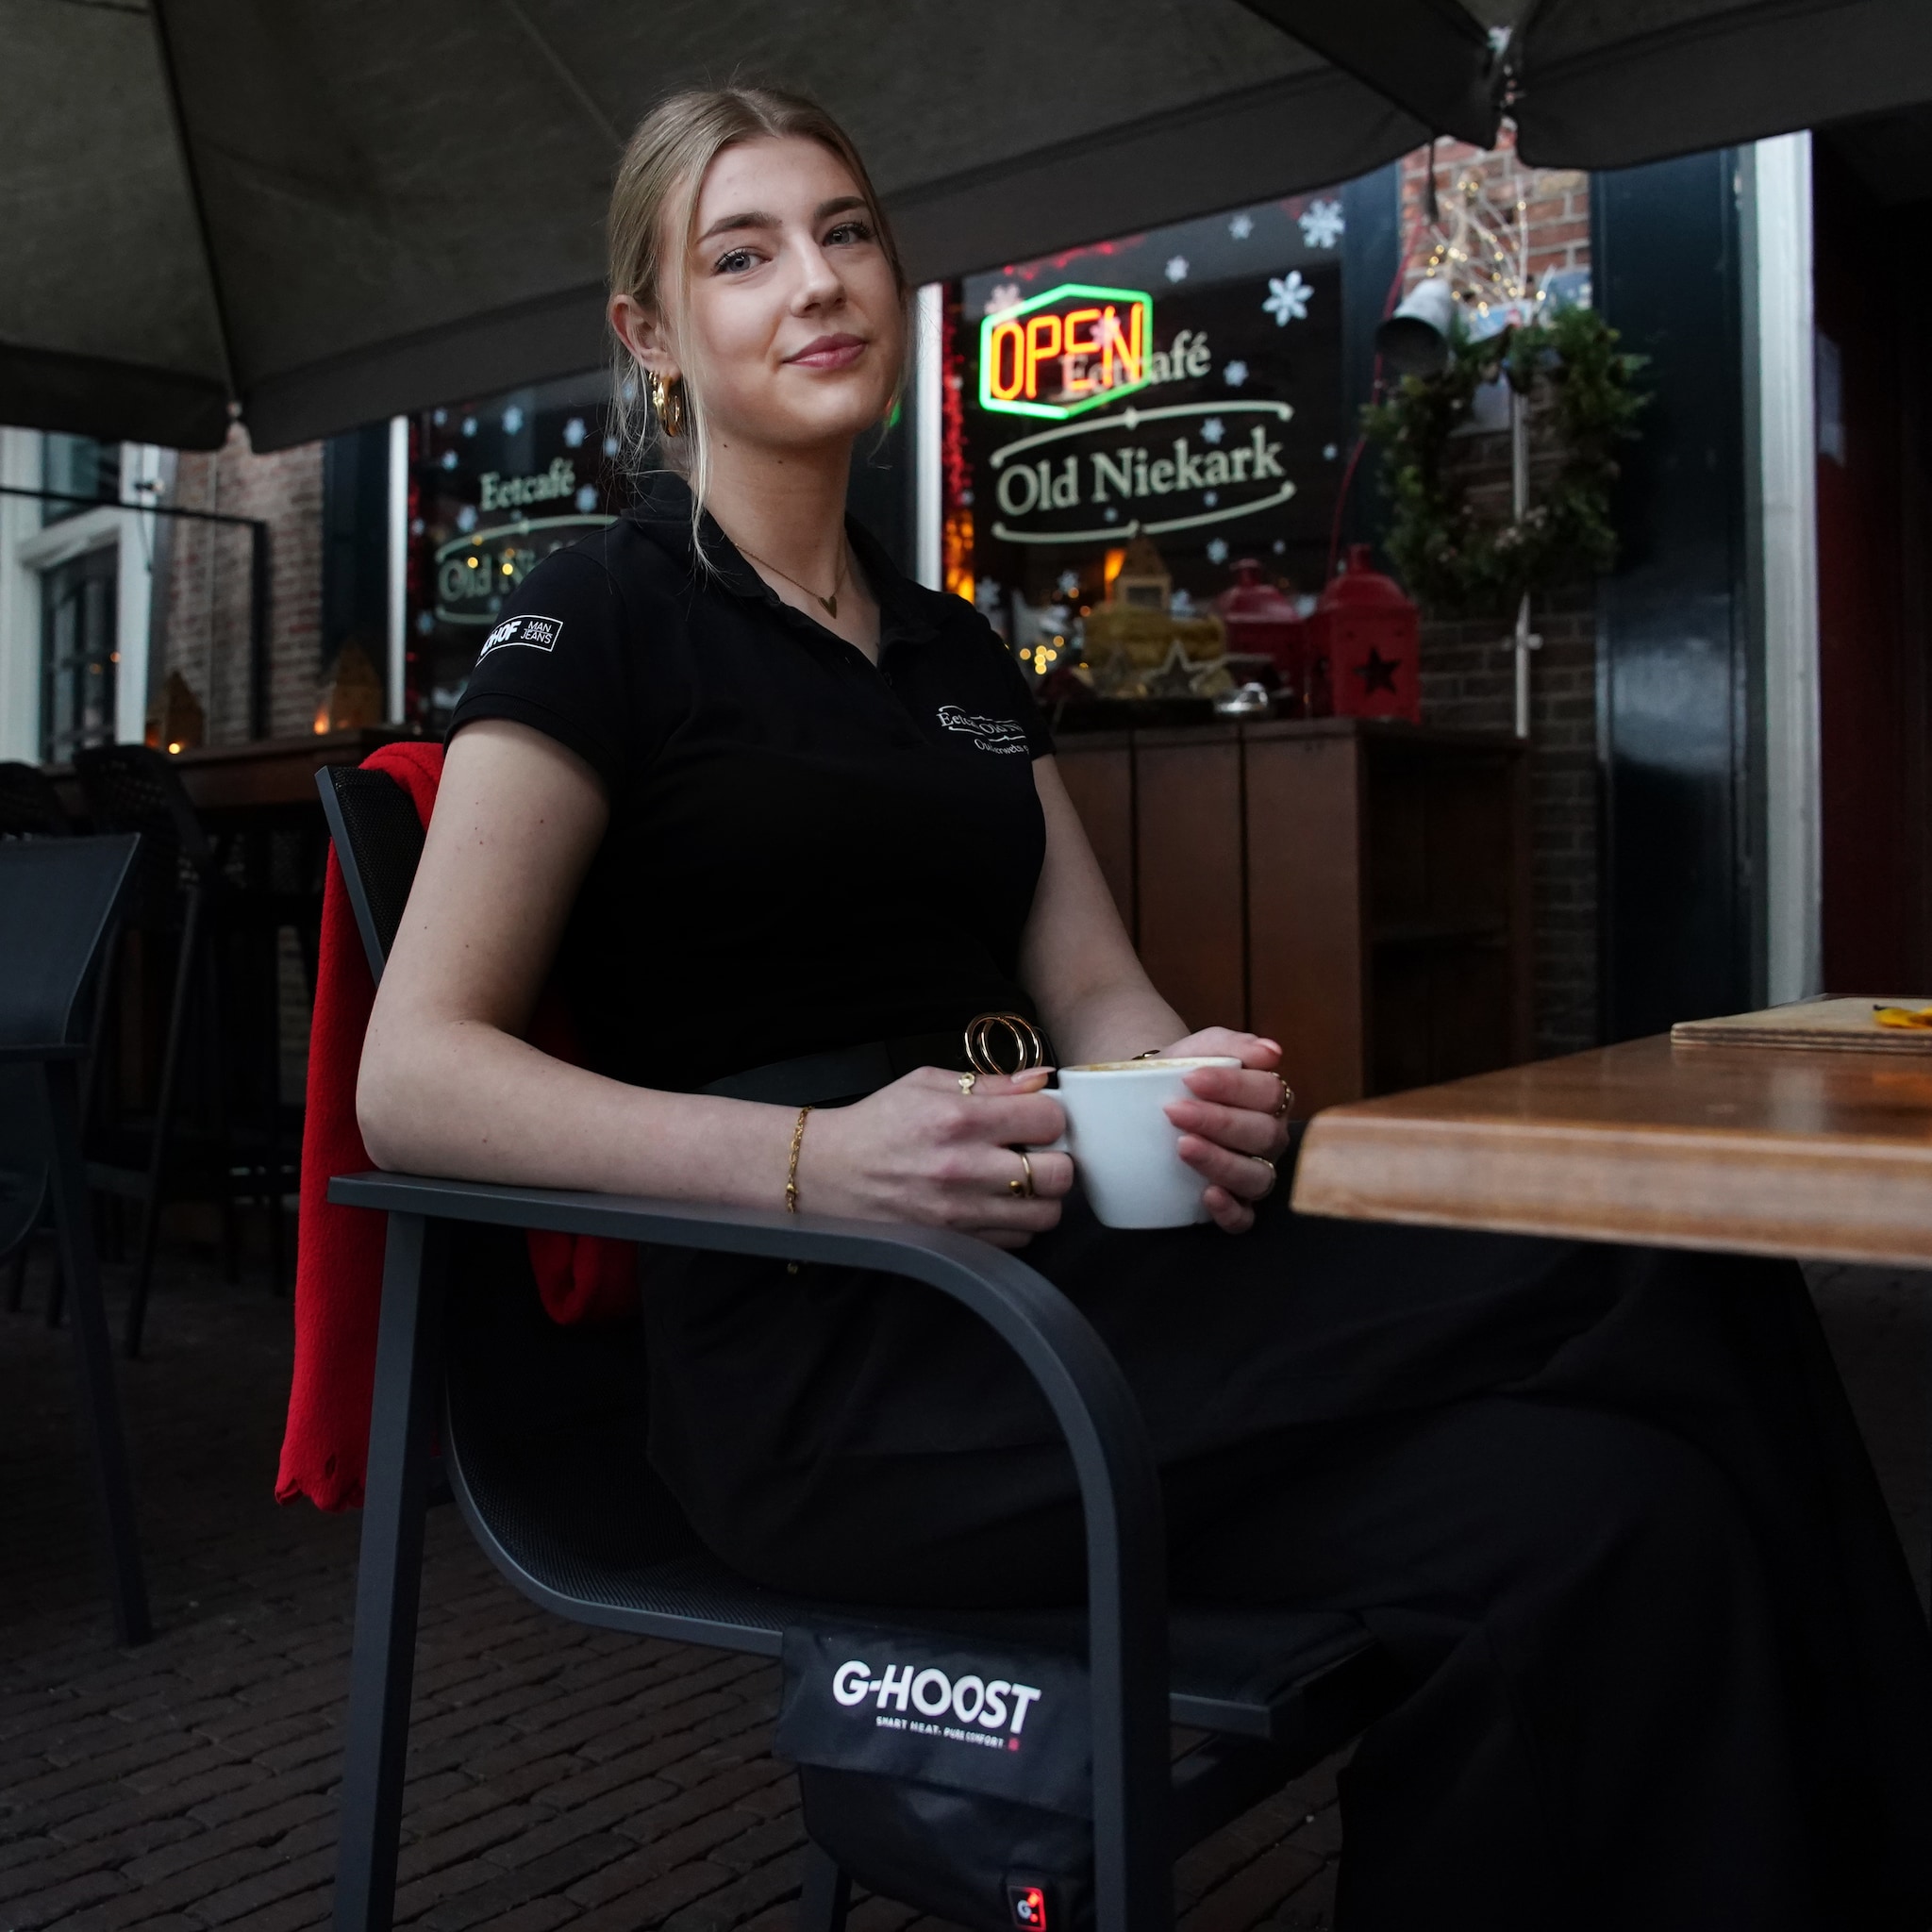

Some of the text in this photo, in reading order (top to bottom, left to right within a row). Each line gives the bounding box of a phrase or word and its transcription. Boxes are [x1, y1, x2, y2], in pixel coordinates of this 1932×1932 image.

[990, 302, 1144, 401] OPEN
[996, 425, 1286, 516] Old Niekark
[438, 553, 492, 601] Old
[521, 628, 553, 644] JEANS
[527, 621, 552, 633] MAN
[832, 1659, 1041, 1734] G-HOOST
[875, 1716, 908, 1730] SMART
[943, 1726, 965, 1740] PURE
